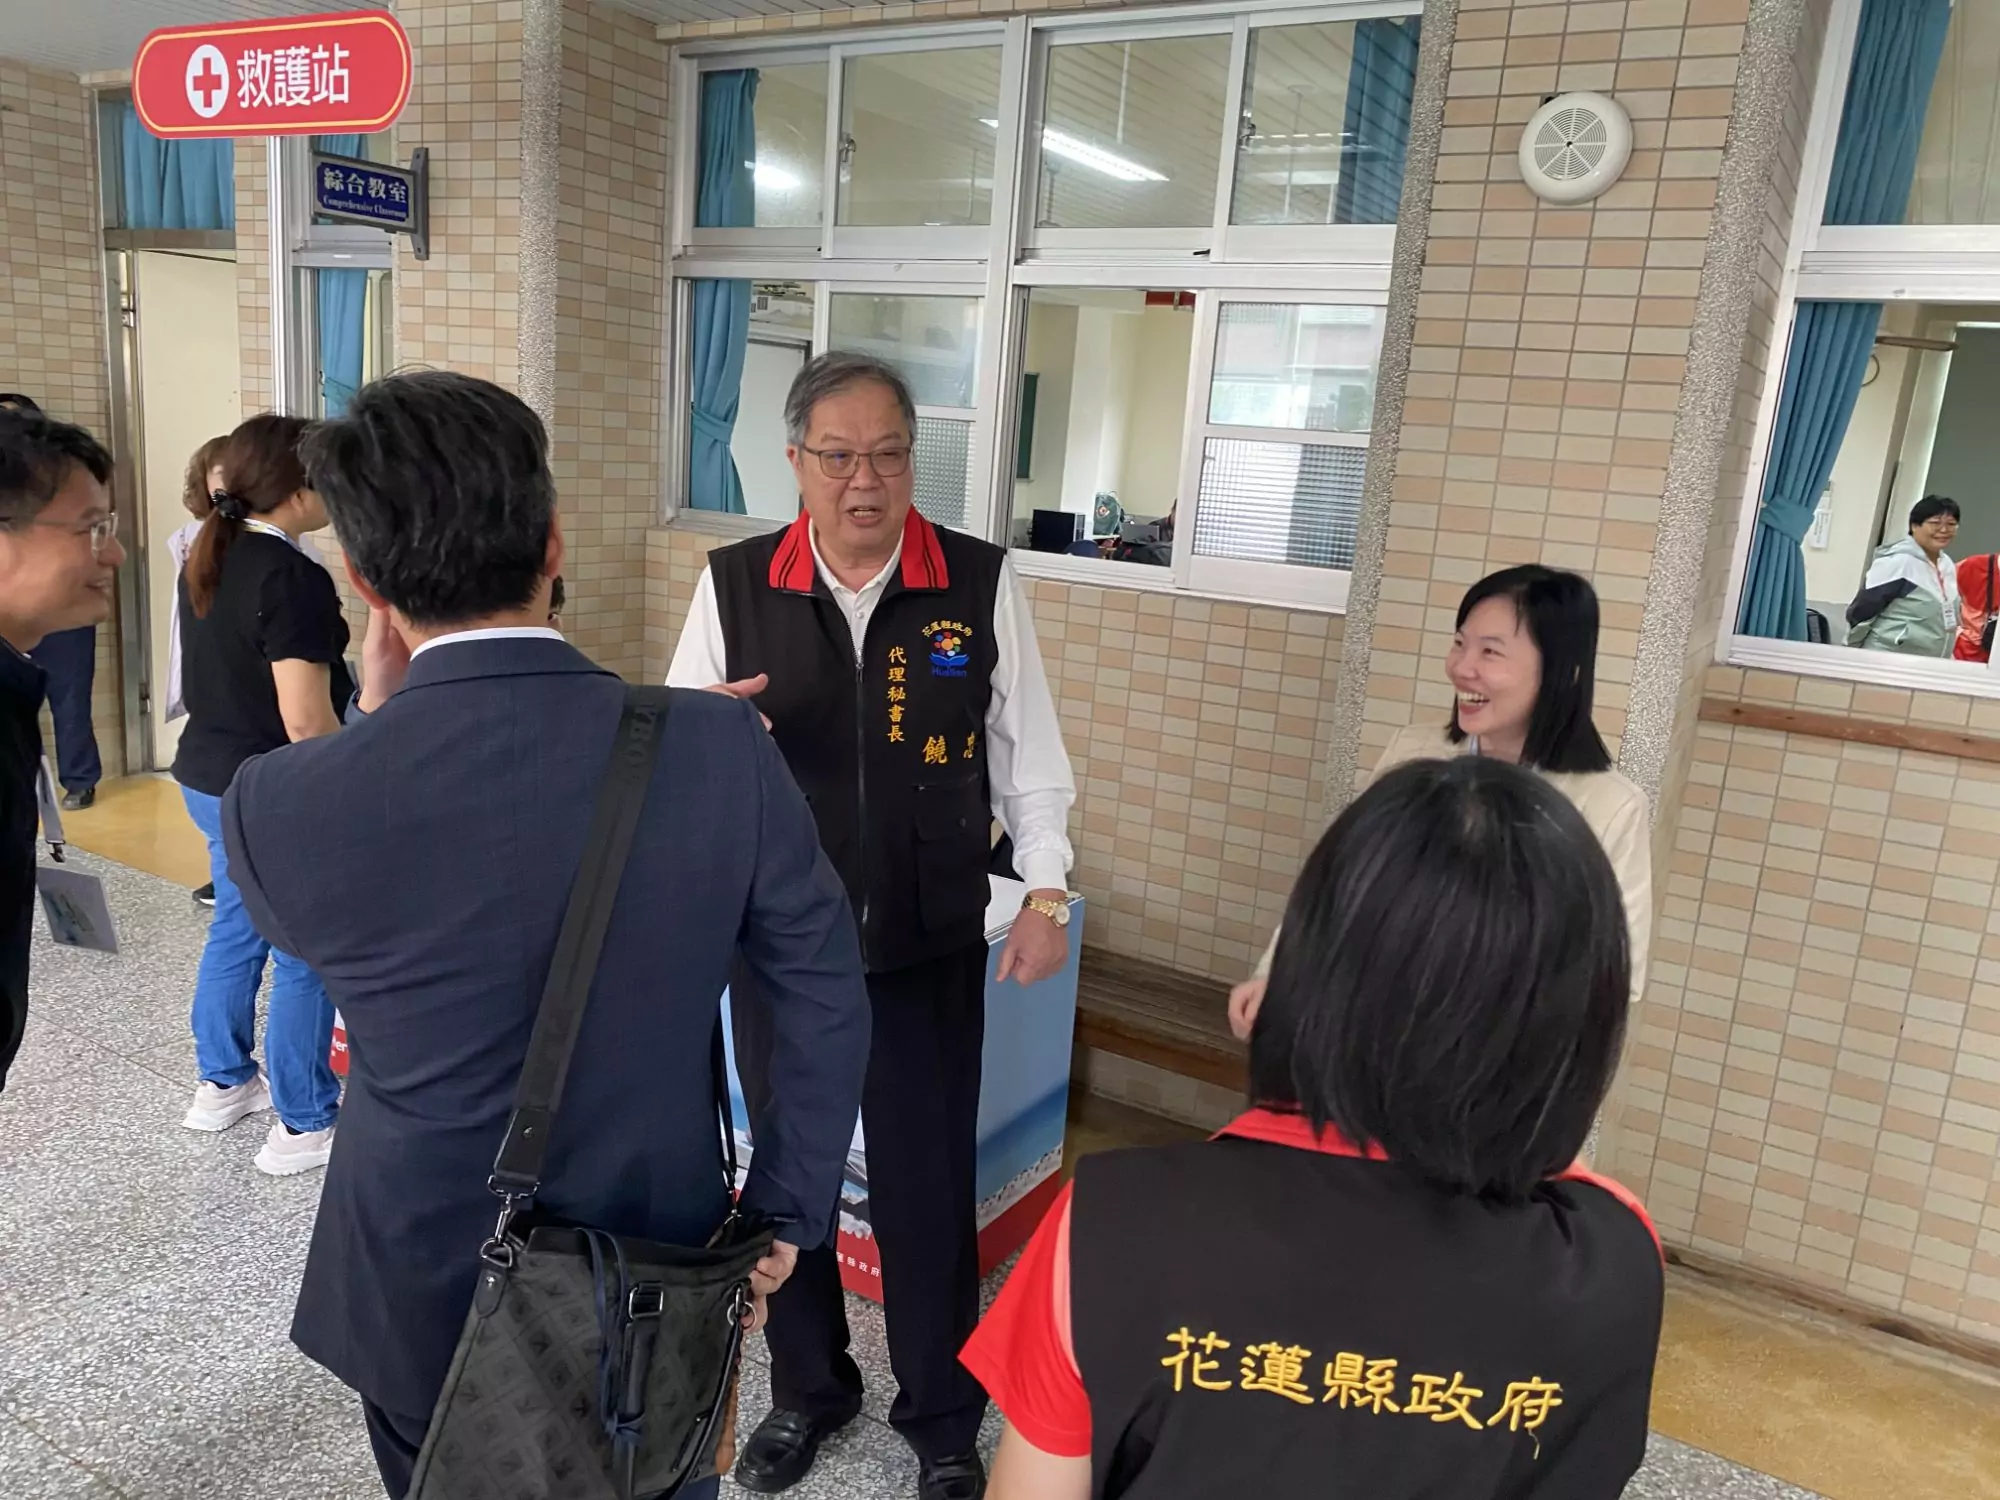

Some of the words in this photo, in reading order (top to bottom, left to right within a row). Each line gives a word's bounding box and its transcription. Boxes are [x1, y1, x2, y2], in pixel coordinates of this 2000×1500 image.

[236, 42, 350, 108] 救護站
[323, 167, 407, 203] 綜合教室
[887, 646, 907, 742] 代理秘書長
[1161, 1326, 1563, 1431] 花蓮縣政府
